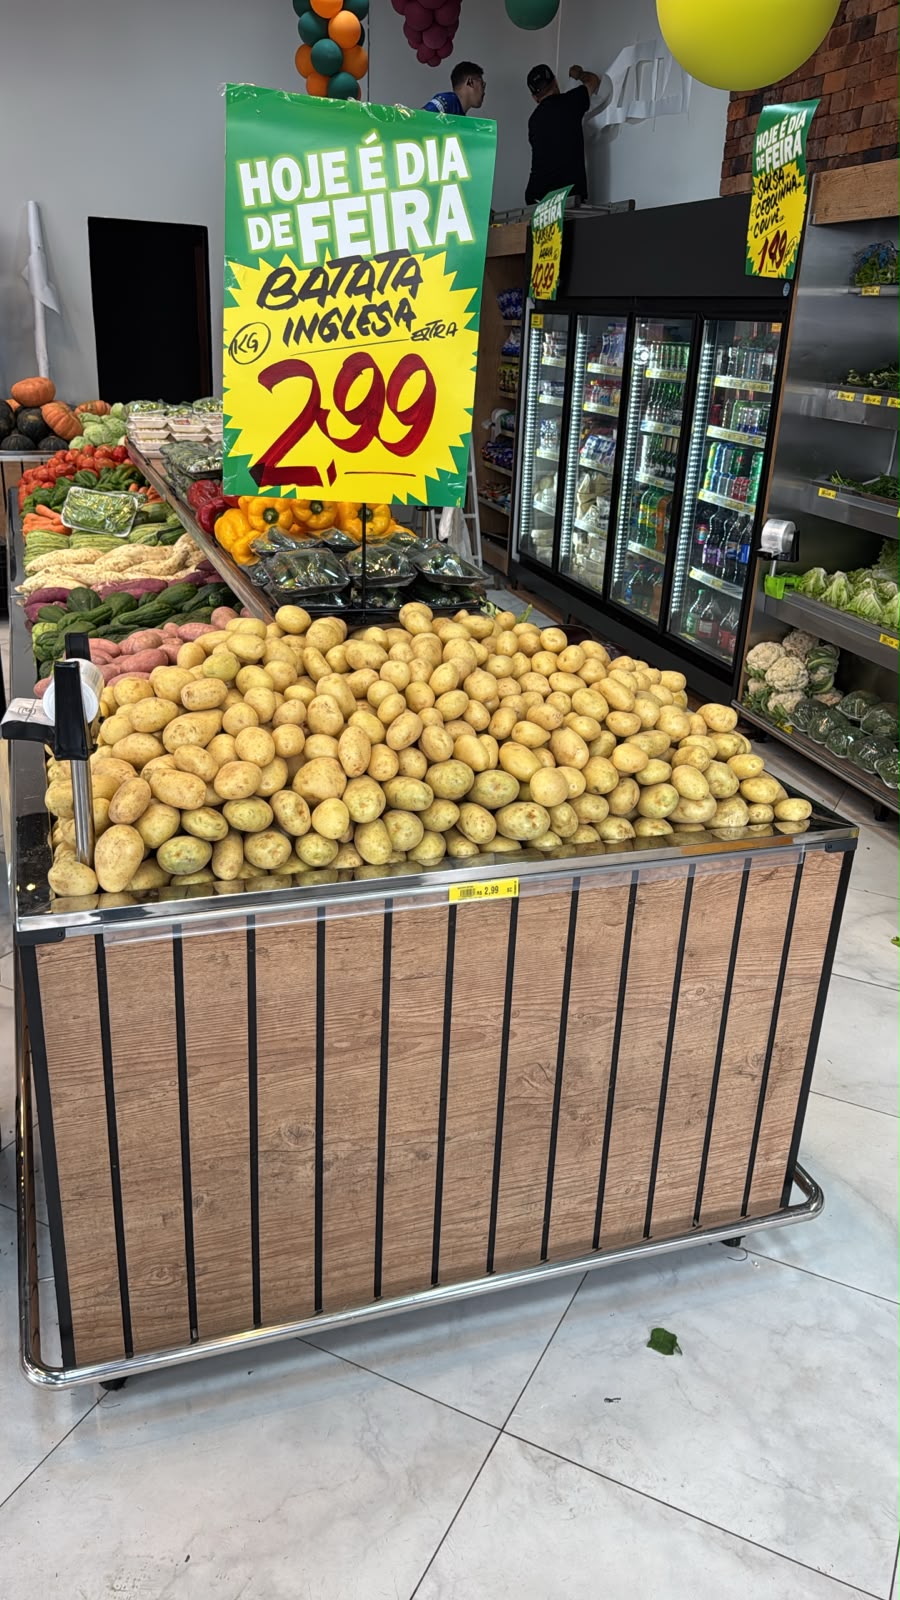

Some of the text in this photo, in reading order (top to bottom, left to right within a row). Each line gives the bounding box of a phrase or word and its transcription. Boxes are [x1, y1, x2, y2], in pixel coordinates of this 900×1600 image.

[756, 109, 807, 153] HOJE É DIA
[756, 130, 802, 173] DE FEIRA
[238, 132, 469, 207] HOJE É DIA
[758, 168, 785, 200] SALSA
[247, 184, 473, 264] DE FEIRA
[540, 202, 562, 229] FEIRA
[754, 208, 780, 239] COUVE
[257, 248, 424, 310] BATATA
[234, 332, 259, 355] KG
[283, 298, 416, 348] INGLESA
[411, 320, 458, 342] EXTRA
[249, 351, 437, 487] 2,99
[484, 886, 499, 895] 2,99
